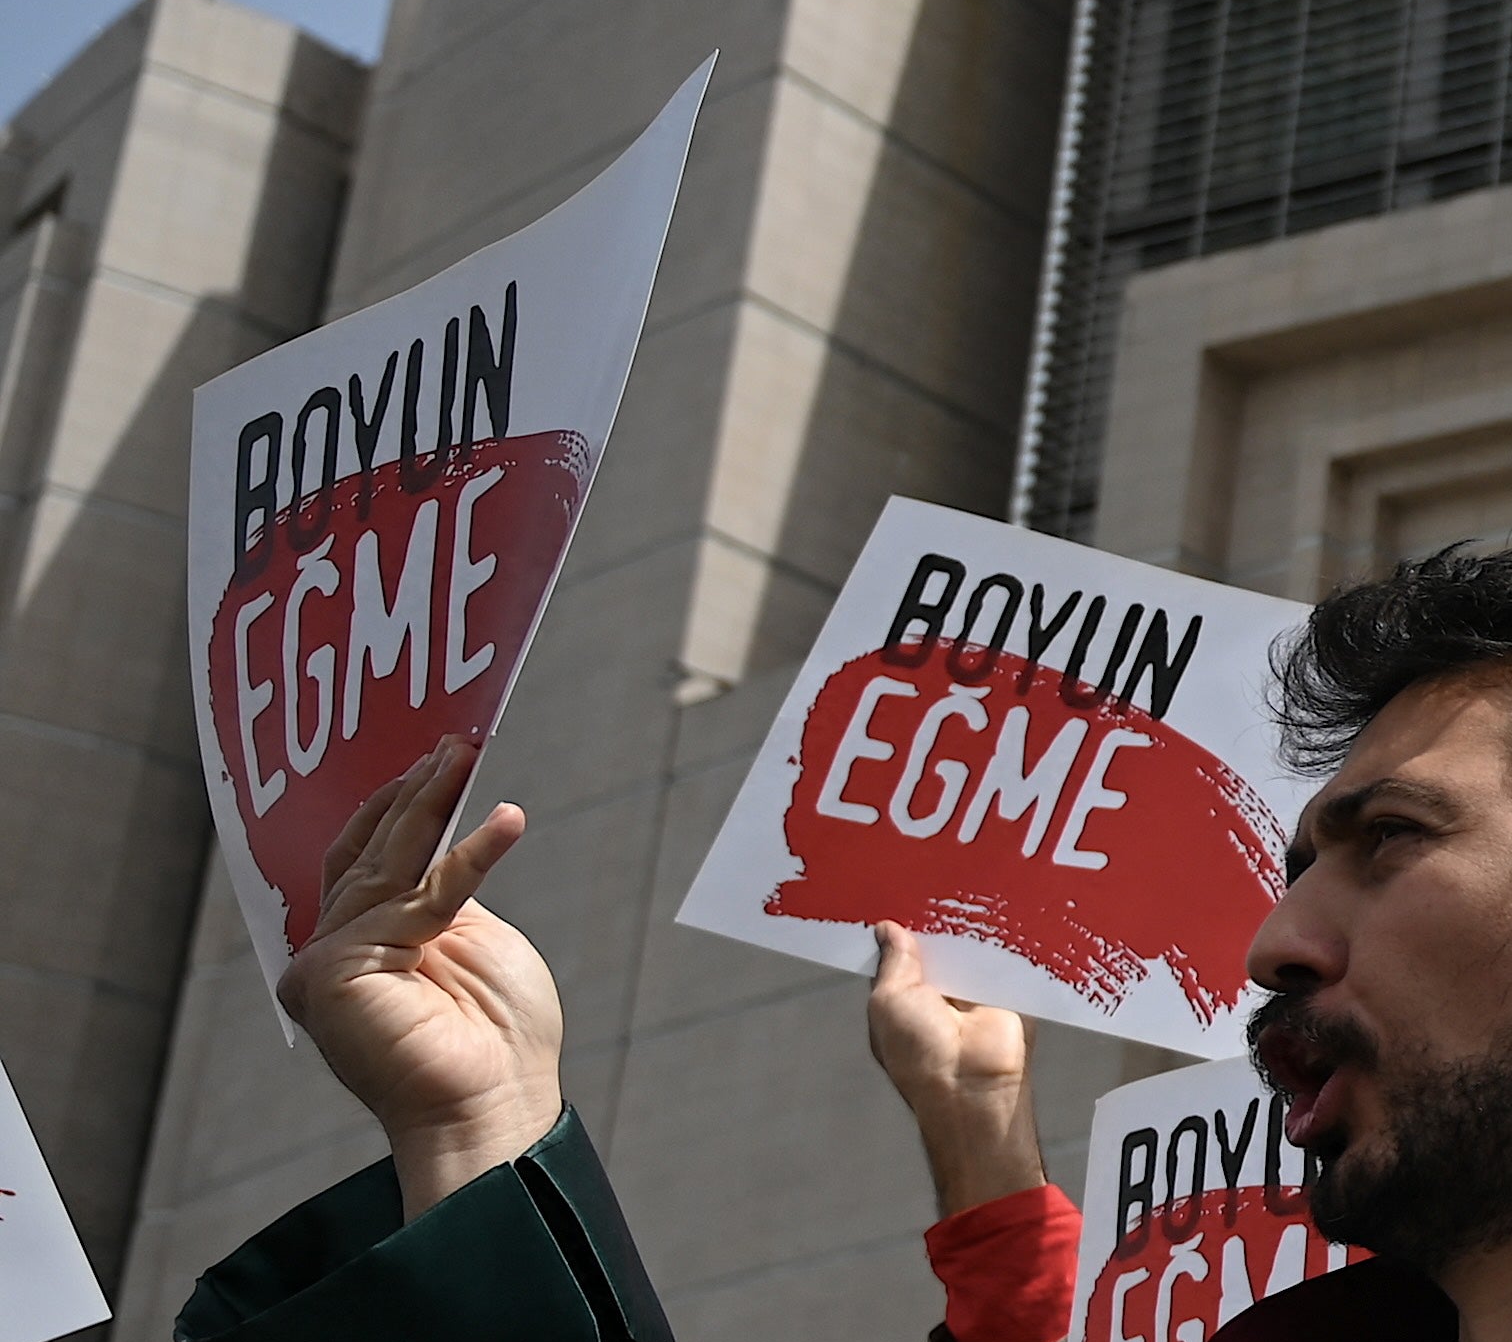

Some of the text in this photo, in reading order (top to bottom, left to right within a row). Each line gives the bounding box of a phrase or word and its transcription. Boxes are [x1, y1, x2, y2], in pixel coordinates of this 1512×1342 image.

[234, 280, 517, 586] BOYUN
[232, 465, 505, 820] EĞME
[880, 553, 1203, 721] BOYUN
[816, 675, 1154, 870] EĞME
